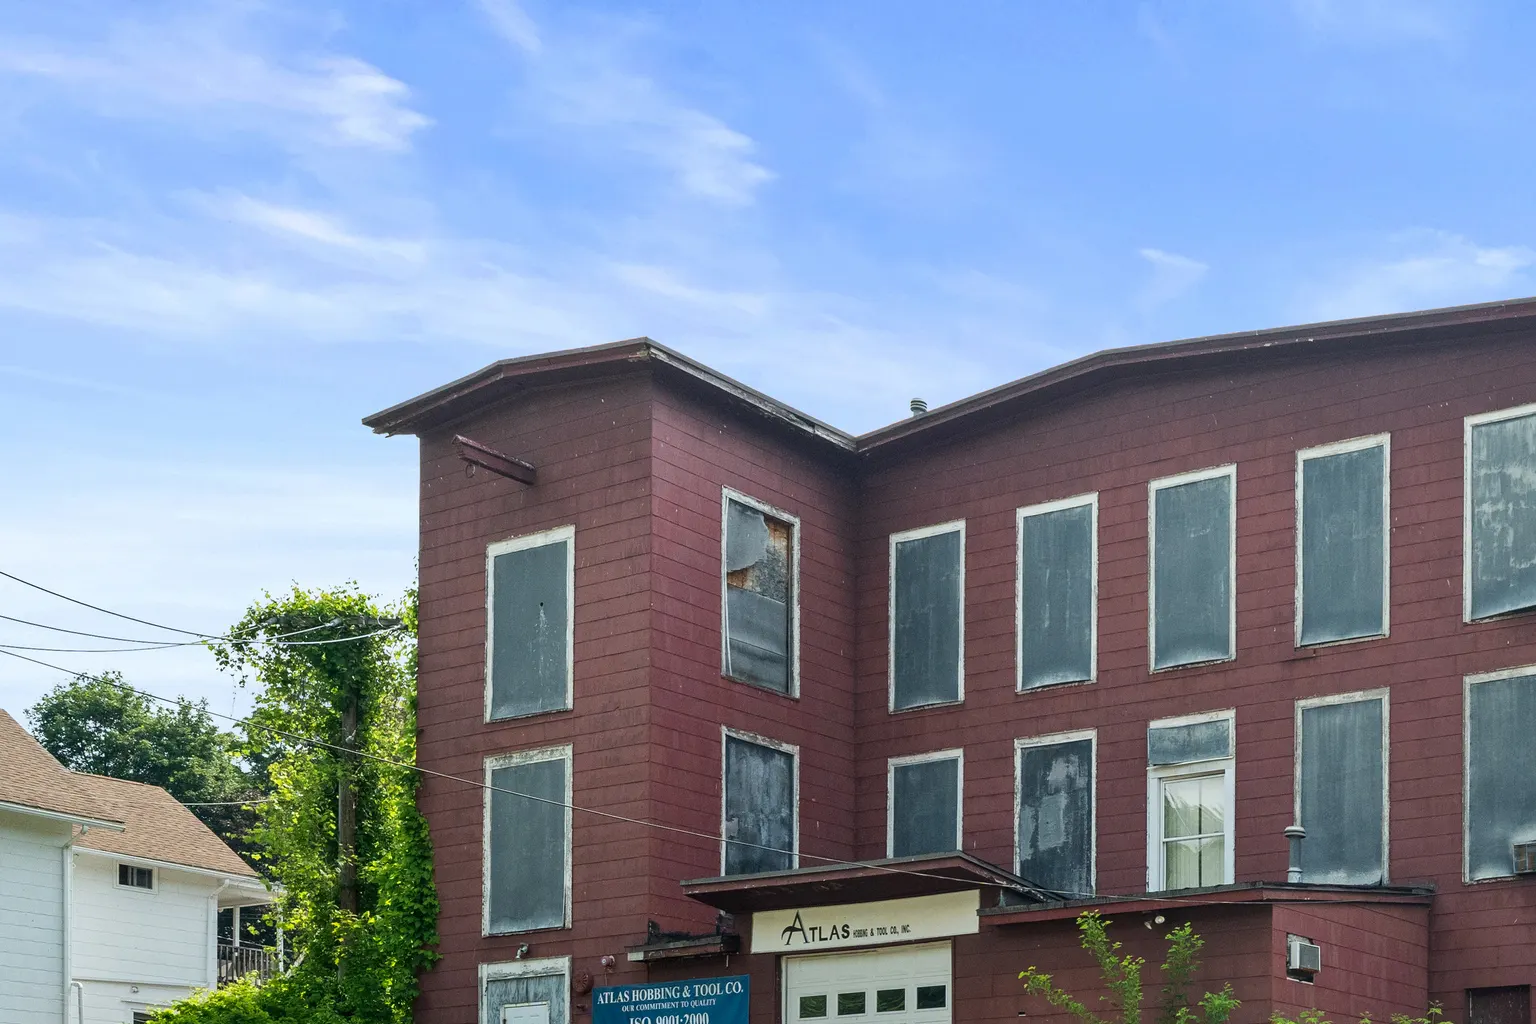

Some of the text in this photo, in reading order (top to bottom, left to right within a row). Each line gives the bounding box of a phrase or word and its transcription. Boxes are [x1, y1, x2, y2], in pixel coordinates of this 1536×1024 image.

[781, 910, 850, 945] ATLAS
[853, 928, 868, 938] HOBBING
[870, 928, 874, 936] &
[877, 927, 888, 935] TOOL
[901, 925, 911, 933] INC.
[597, 981, 744, 1004] ATLAS HOBBING & TOOL CO.
[636, 1002, 679, 1011] COMMITMENT
[690, 999, 716, 1008] QUALITY
